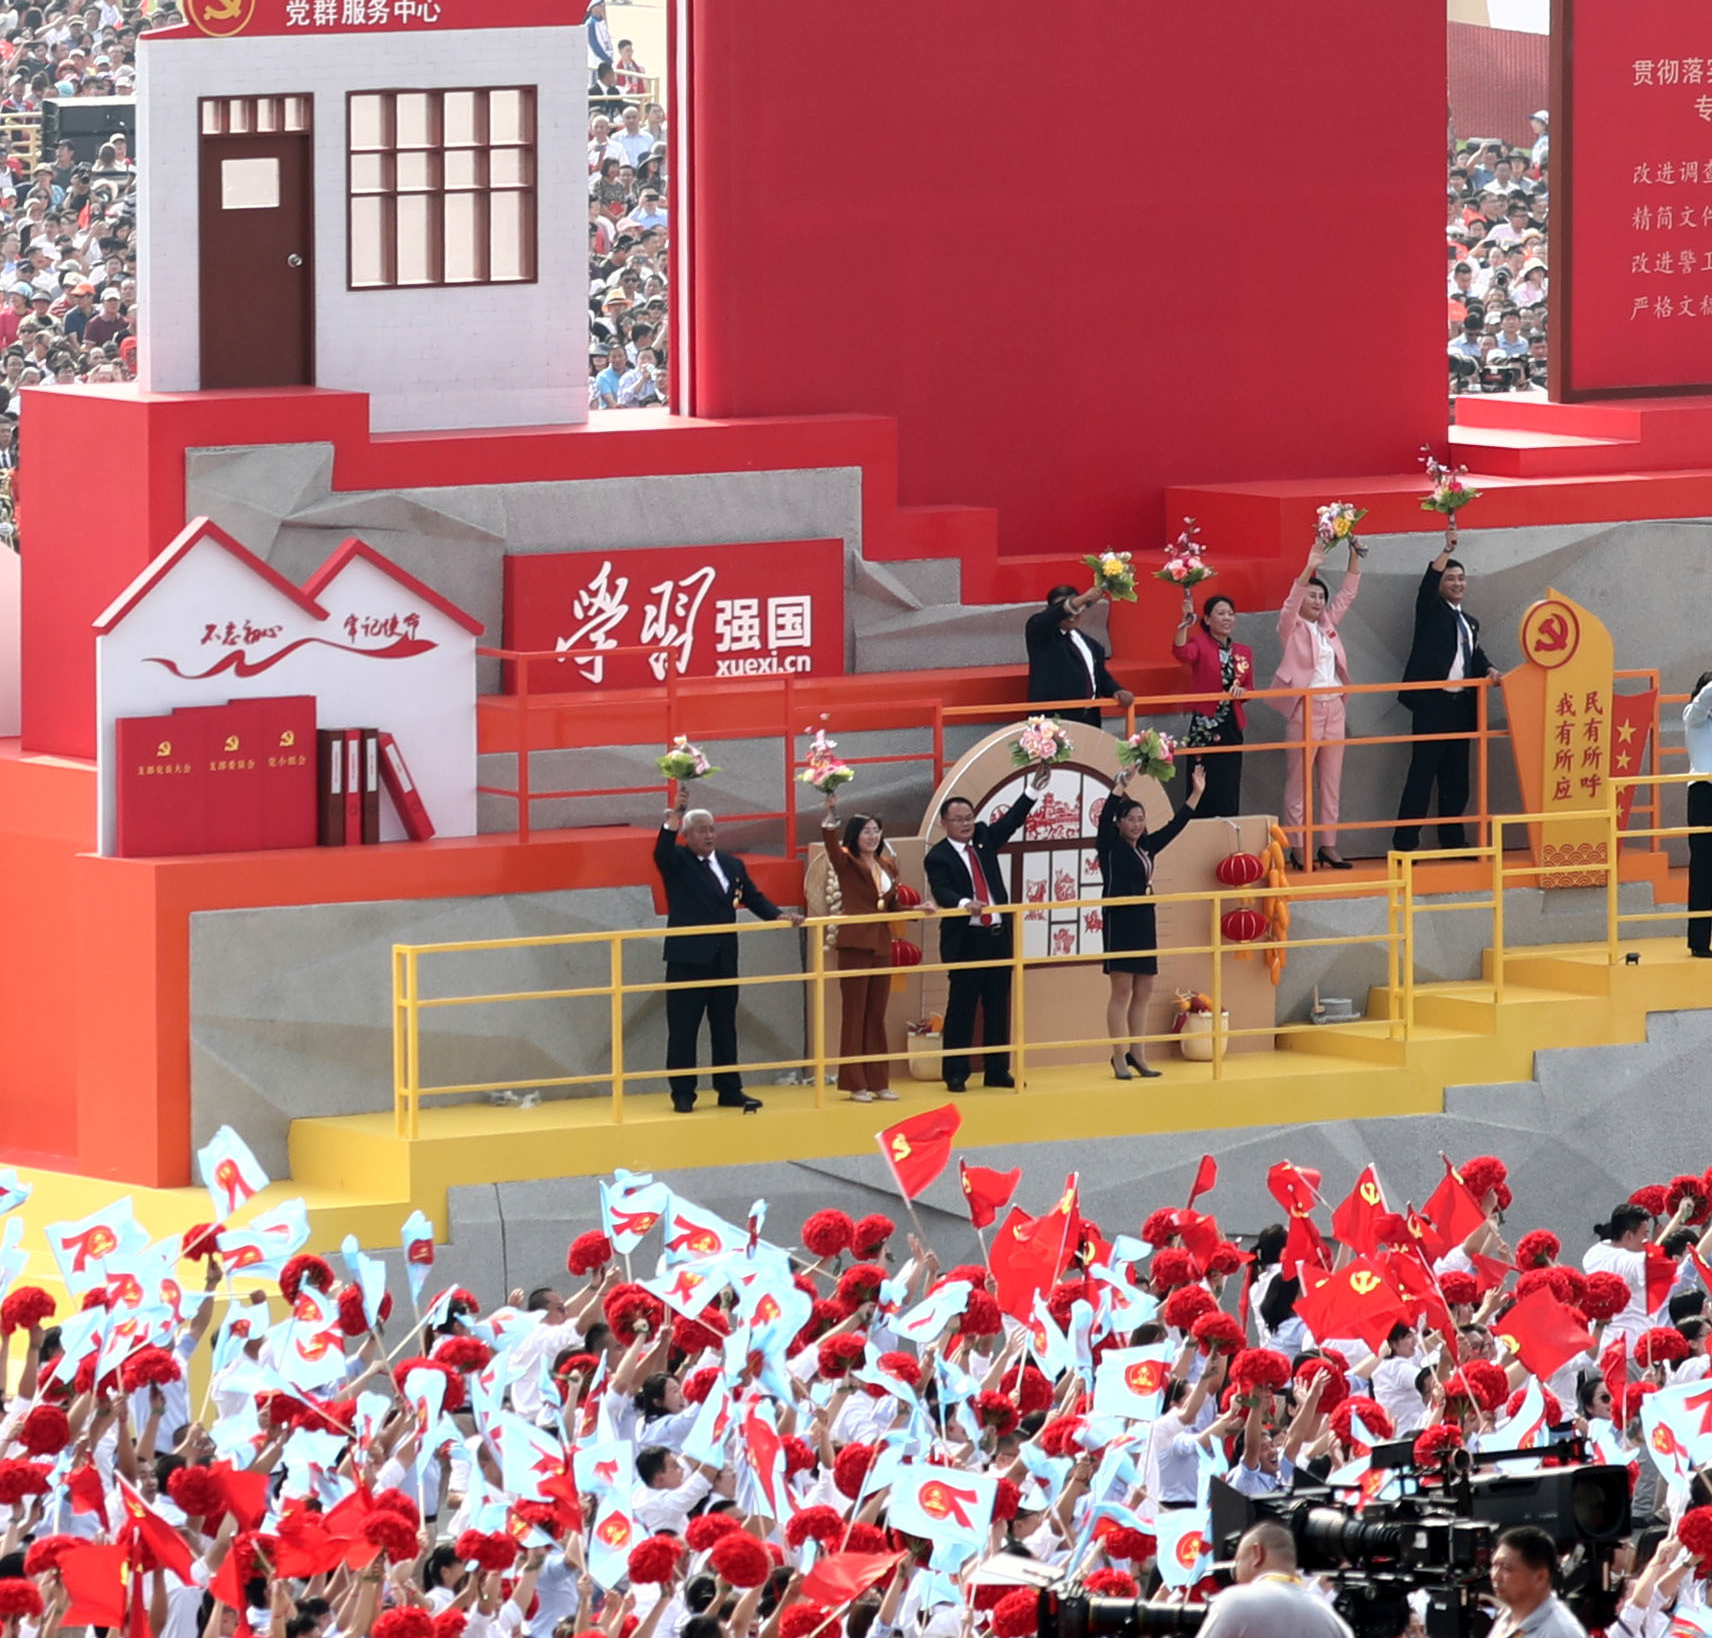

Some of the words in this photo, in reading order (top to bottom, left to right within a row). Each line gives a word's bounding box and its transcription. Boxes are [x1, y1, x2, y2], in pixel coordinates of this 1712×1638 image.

[716, 650, 812, 677] xuexi.cn
[1551, 693, 1577, 802] 我有所应
[1580, 689, 1605, 799] 民有所呼
